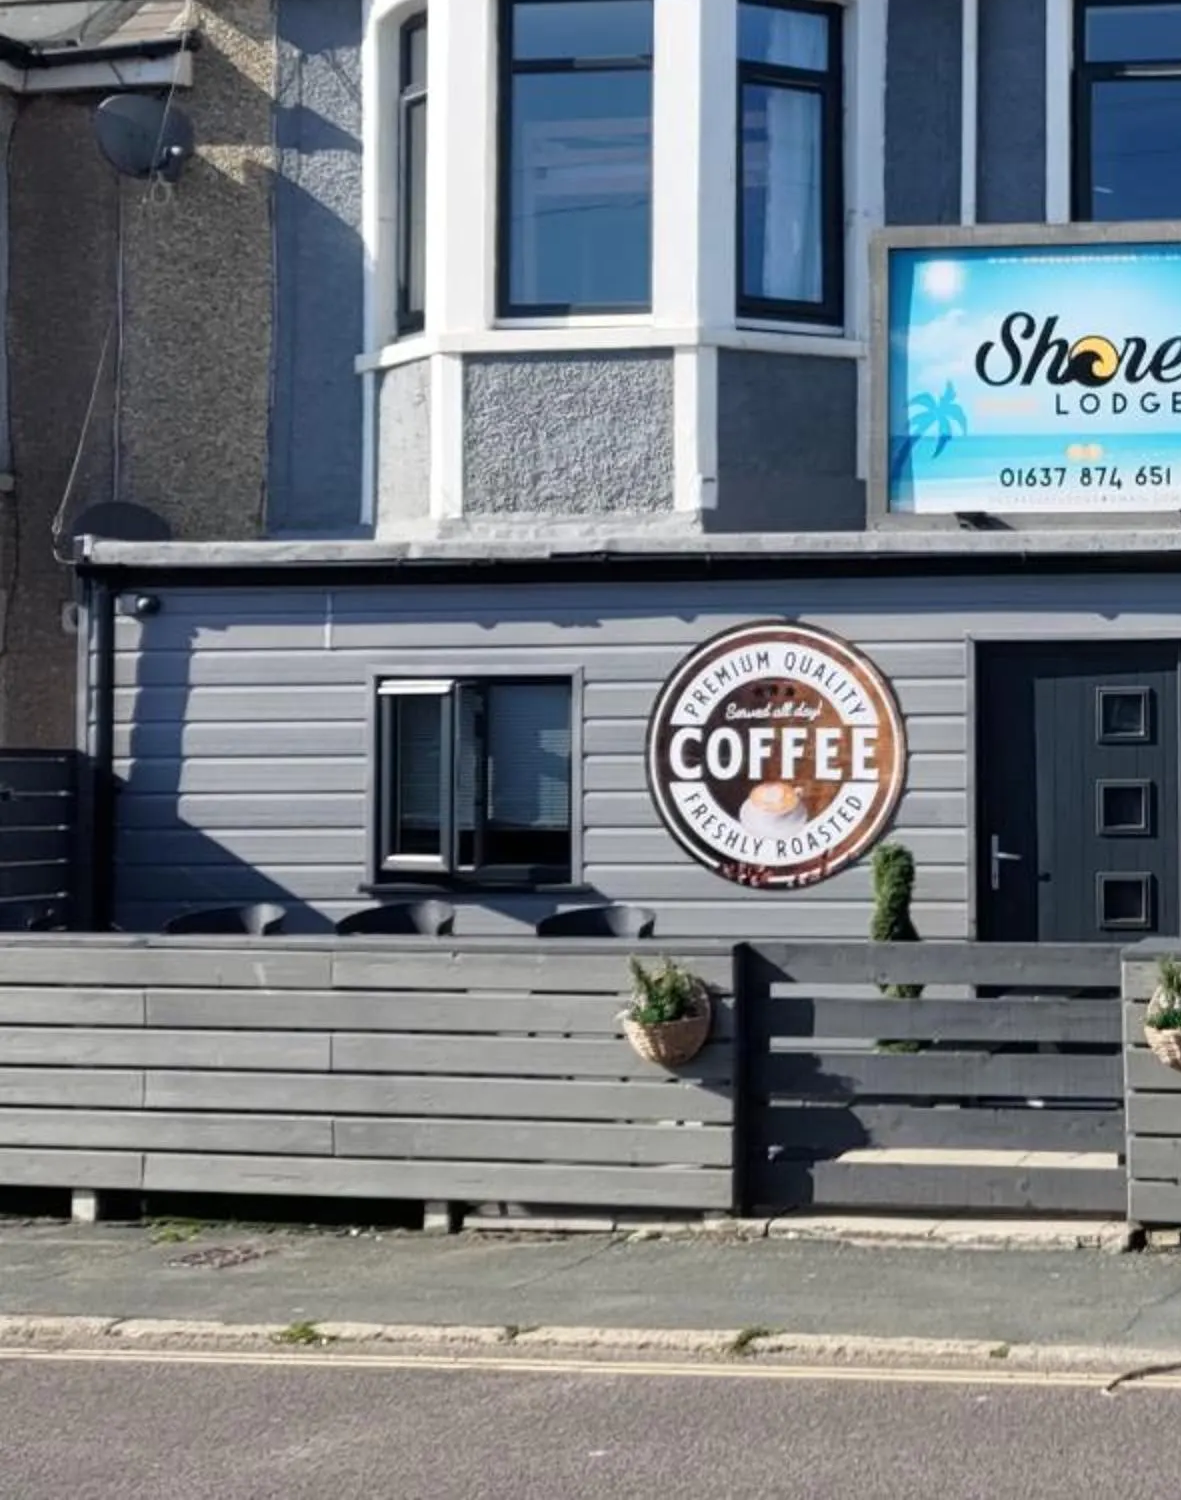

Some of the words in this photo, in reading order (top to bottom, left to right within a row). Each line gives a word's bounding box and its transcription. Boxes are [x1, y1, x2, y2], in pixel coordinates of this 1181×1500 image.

[1001, 467, 1067, 488] 01637
[1080, 467, 1122, 489] 874
[1136, 465, 1171, 486] 651
[684, 652, 770, 718] PREMIUM
[784, 651, 866, 716] QUALITY
[725, 703, 771, 721] Served
[772, 702, 796, 718] all
[669, 726, 879, 781] COFFEE
[684, 792, 764, 857] FRESHLY
[777, 794, 862, 858] ROASTED
